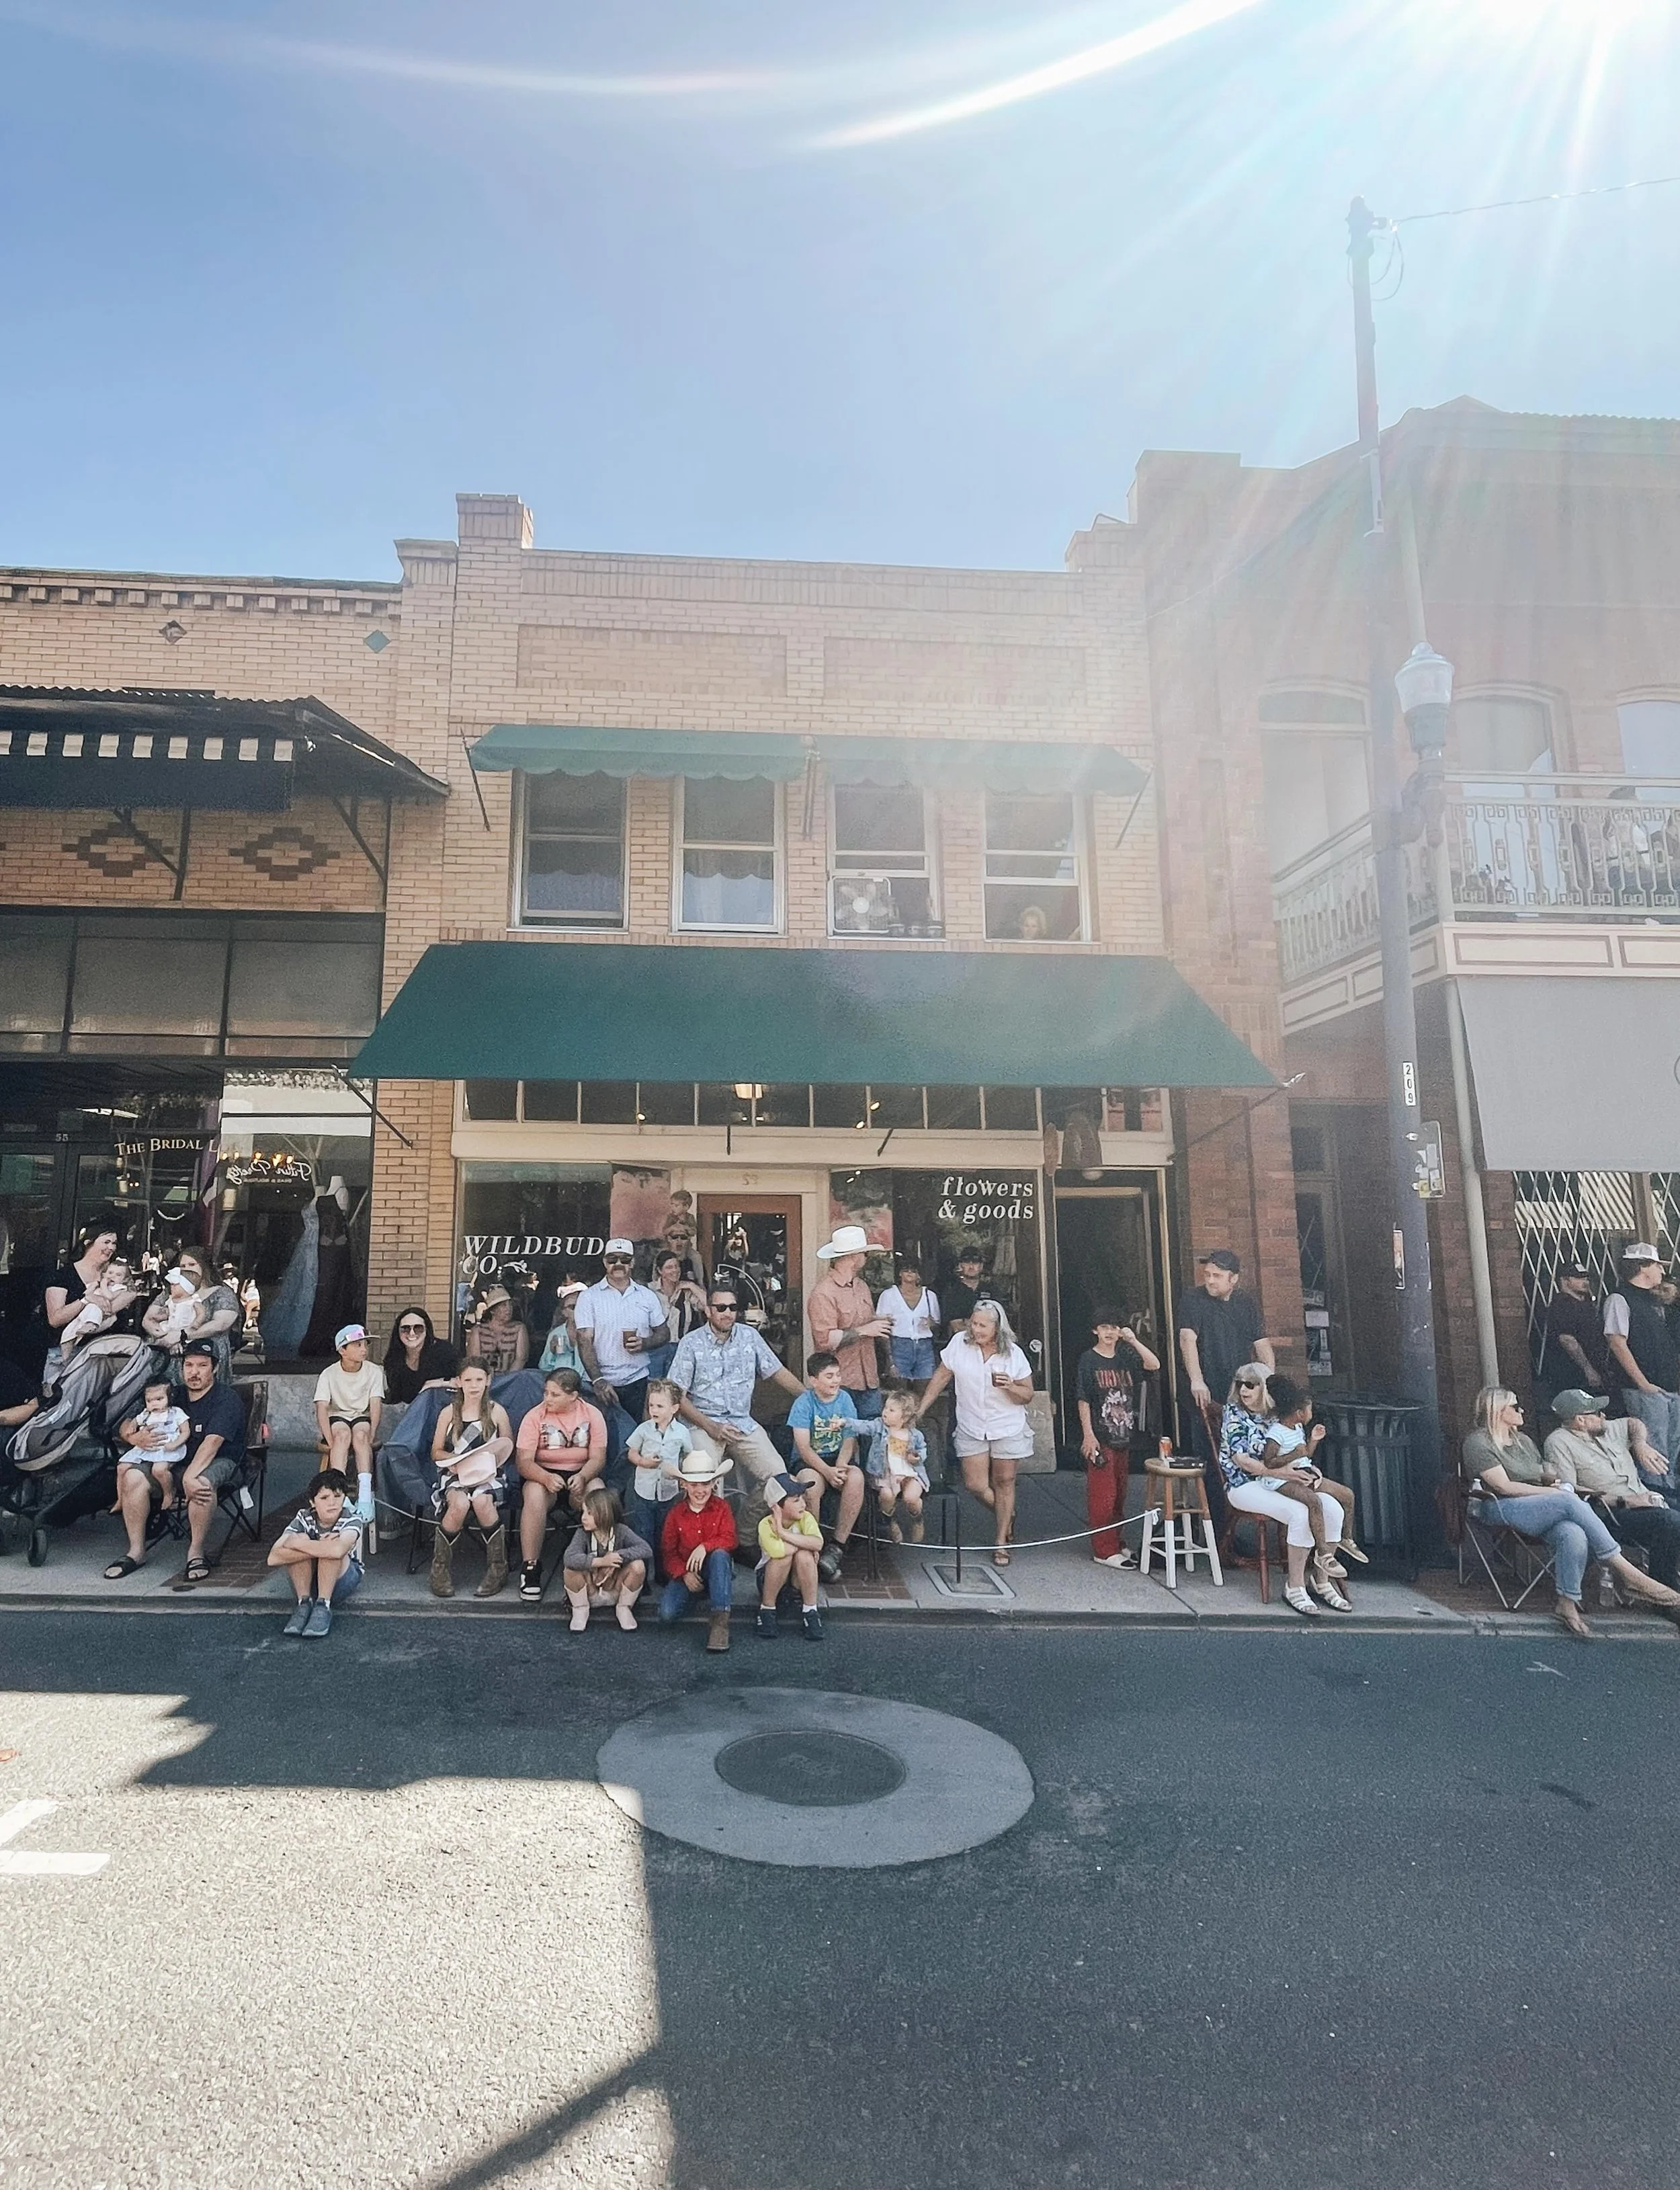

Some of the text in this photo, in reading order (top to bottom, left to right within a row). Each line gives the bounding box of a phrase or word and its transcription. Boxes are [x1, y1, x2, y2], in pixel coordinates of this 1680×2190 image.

[1405, 1064, 1414, 1103] 209
[114, 1142, 145, 1155] THE
[150, 1138, 204, 1151] BRIDAL
[941, 1176, 1034, 1197] flowers
[938, 1199, 1034, 1224] & goods
[464, 1235, 604, 1256] WILDBUD
